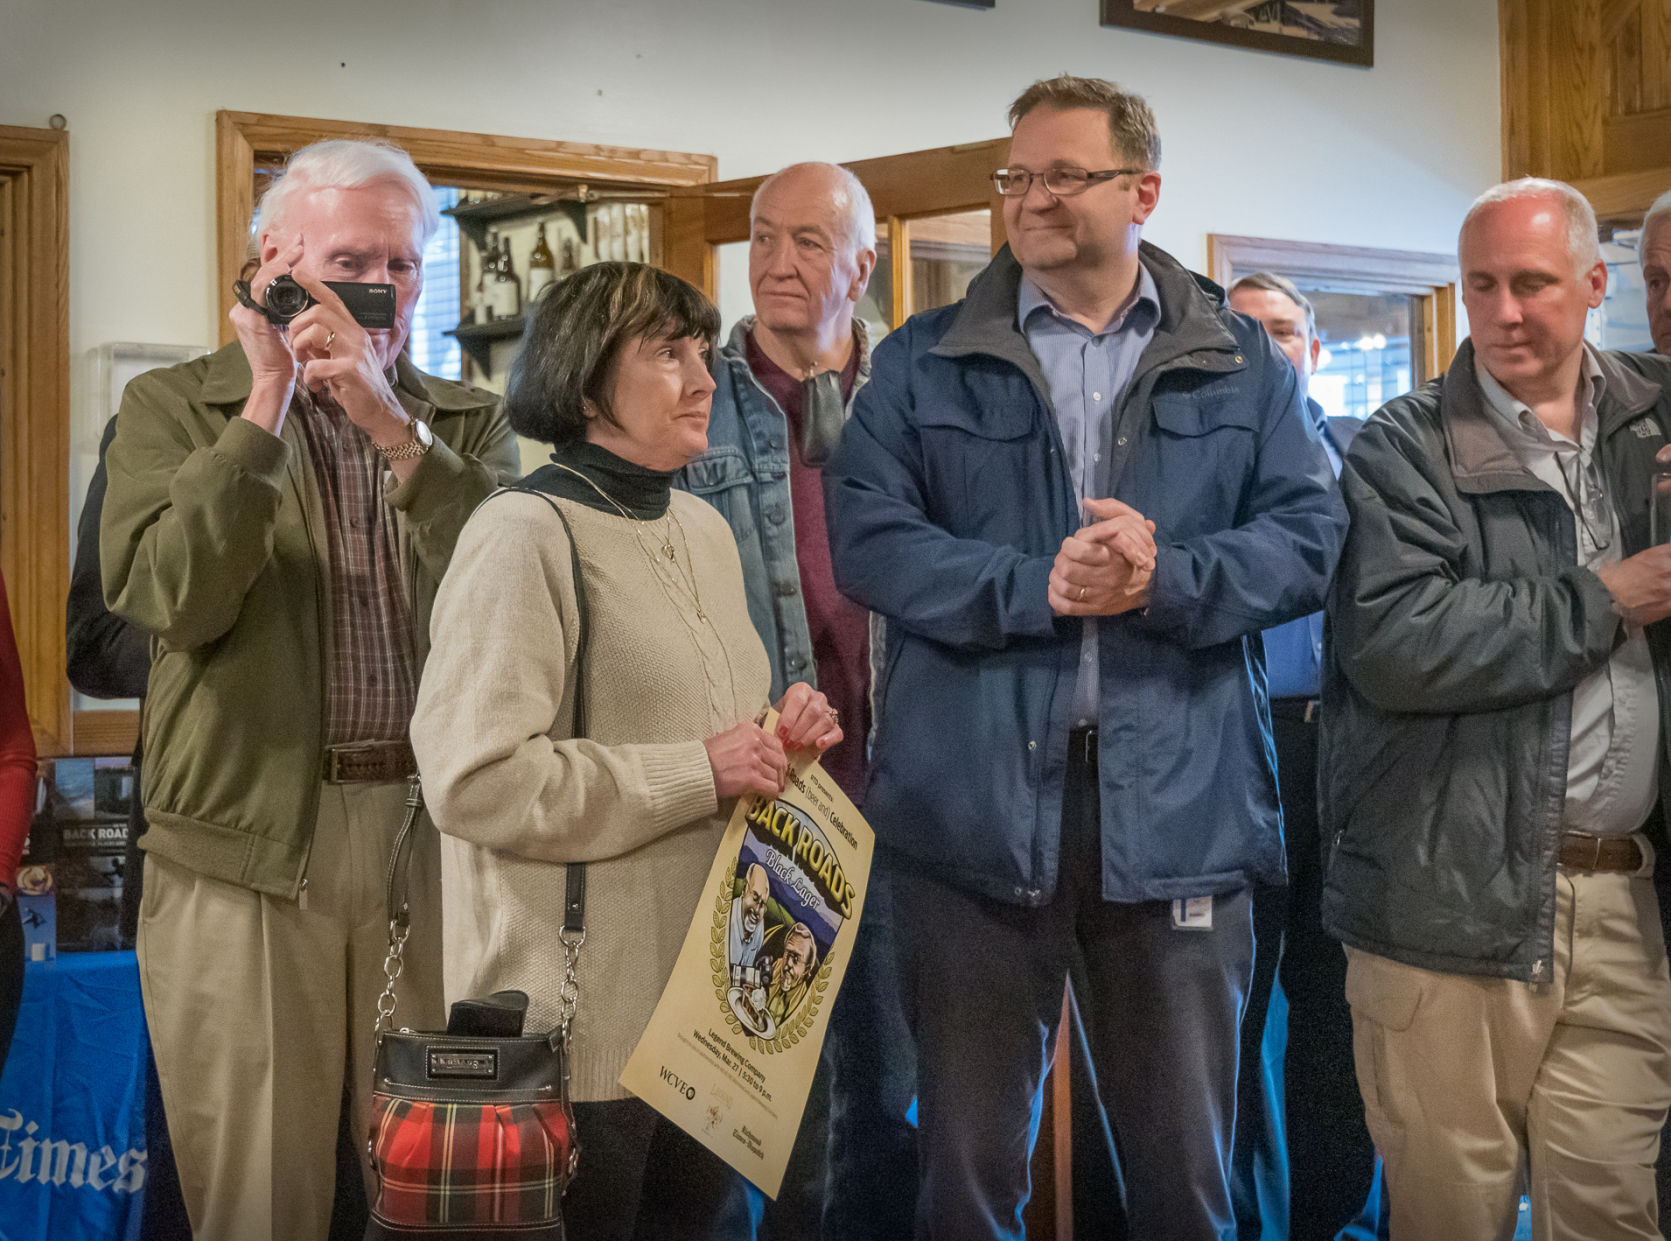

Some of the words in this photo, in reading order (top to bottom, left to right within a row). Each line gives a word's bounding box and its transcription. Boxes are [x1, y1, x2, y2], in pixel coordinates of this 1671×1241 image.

[63, 828, 96, 840] BACK
[789, 767, 806, 794] Roads
[829, 811, 858, 849] Celebration
[746, 797, 800, 848] BACK
[797, 825, 856, 920] ROADS
[766, 848, 795, 884] Black
[791, 878, 820, 909] Lager
[693, 1029, 721, 1059] Wednesday,
[732, 1062, 739, 1072] 27
[708, 1028, 727, 1048] Legend
[725, 1042, 745, 1065] Brewing
[744, 1059, 766, 1083] Company
[660, 1065, 688, 1095] WCVE
[0, 1108, 148, 1193] Times
